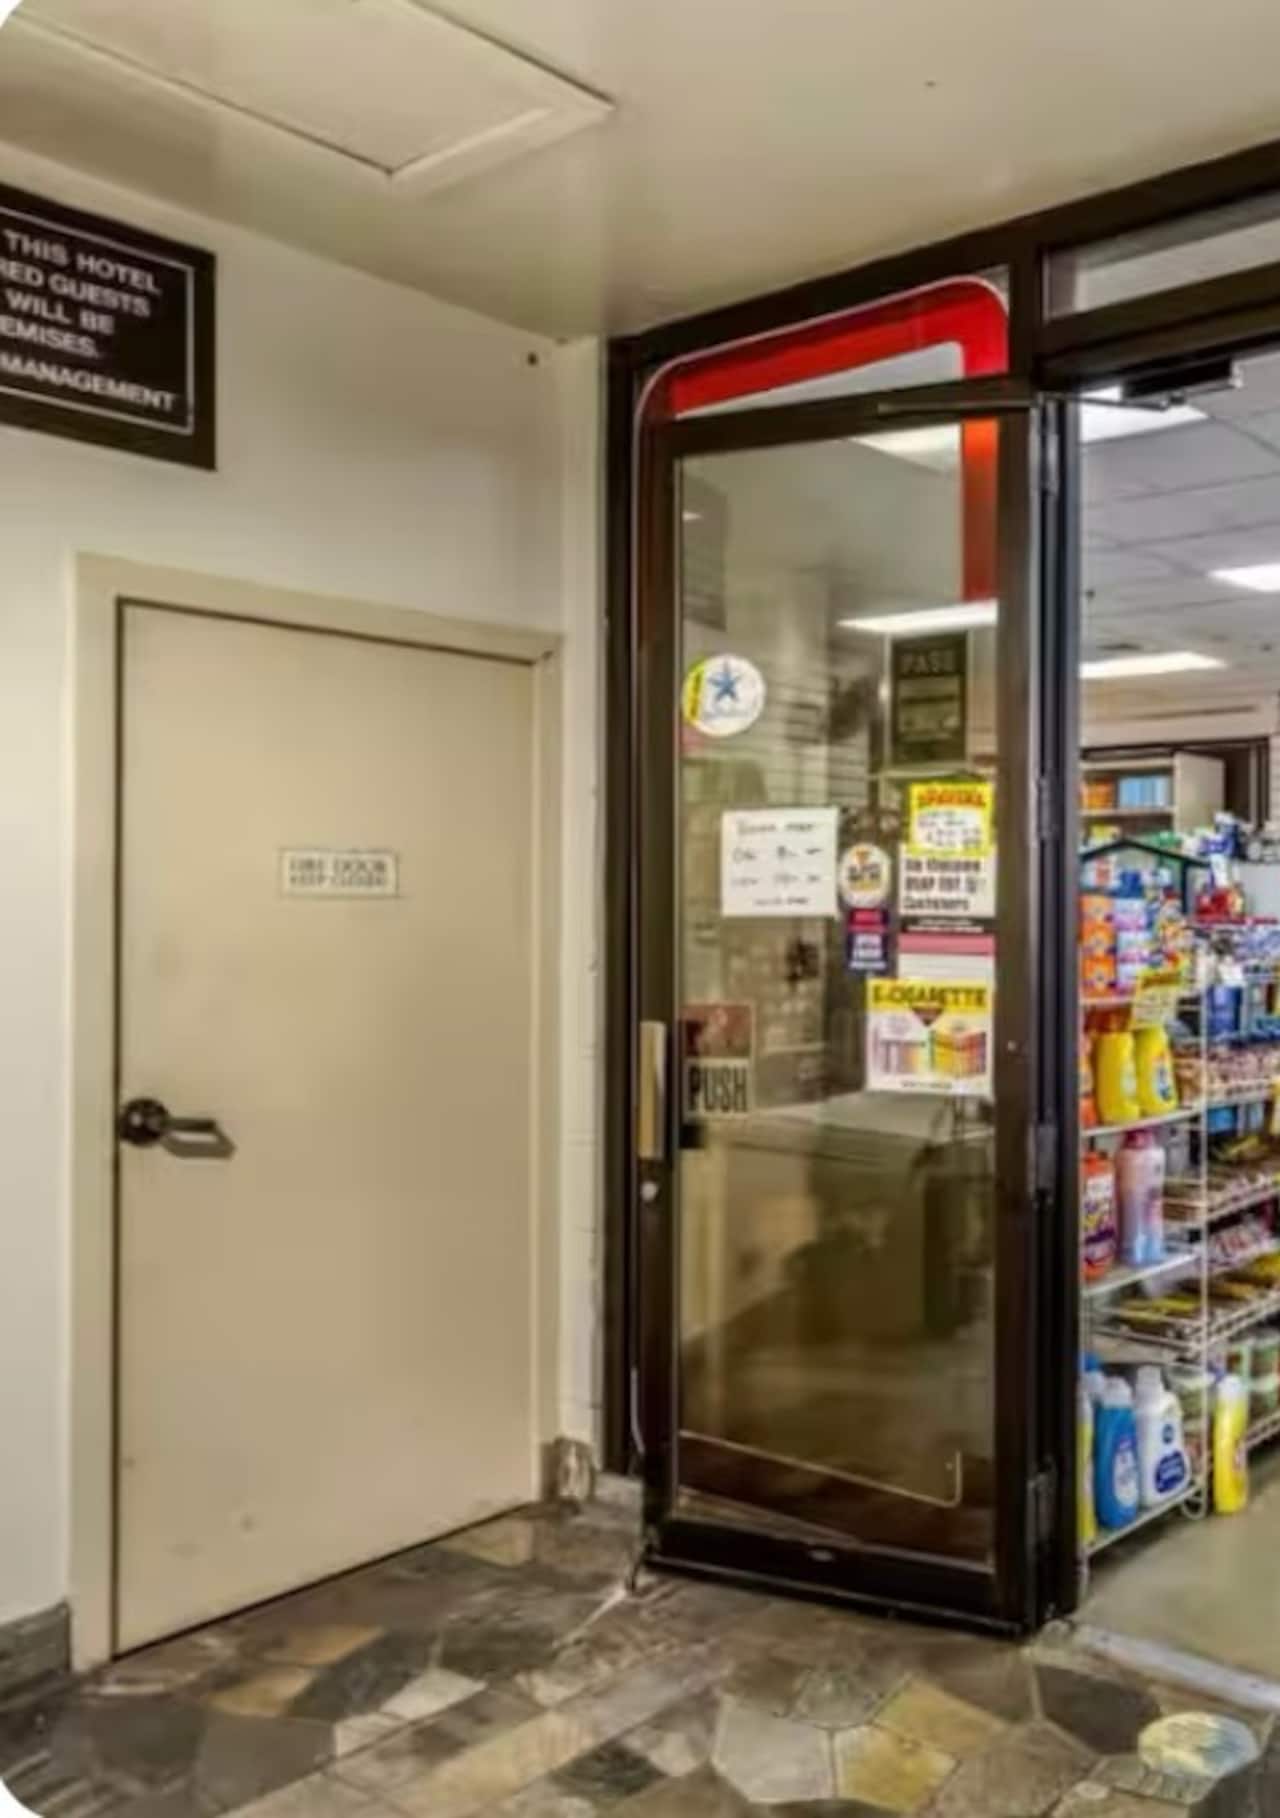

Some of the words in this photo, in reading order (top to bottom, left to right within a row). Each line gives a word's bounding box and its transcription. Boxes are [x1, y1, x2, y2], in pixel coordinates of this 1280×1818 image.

[3, 229, 69, 266] THIS
[76, 253, 161, 295] HOTEL
[5, 288, 71, 324] WILL
[79, 309, 114, 334] BE
[49, 273, 150, 317] GUESTS
[688, 1065, 748, 1113] PUSH
